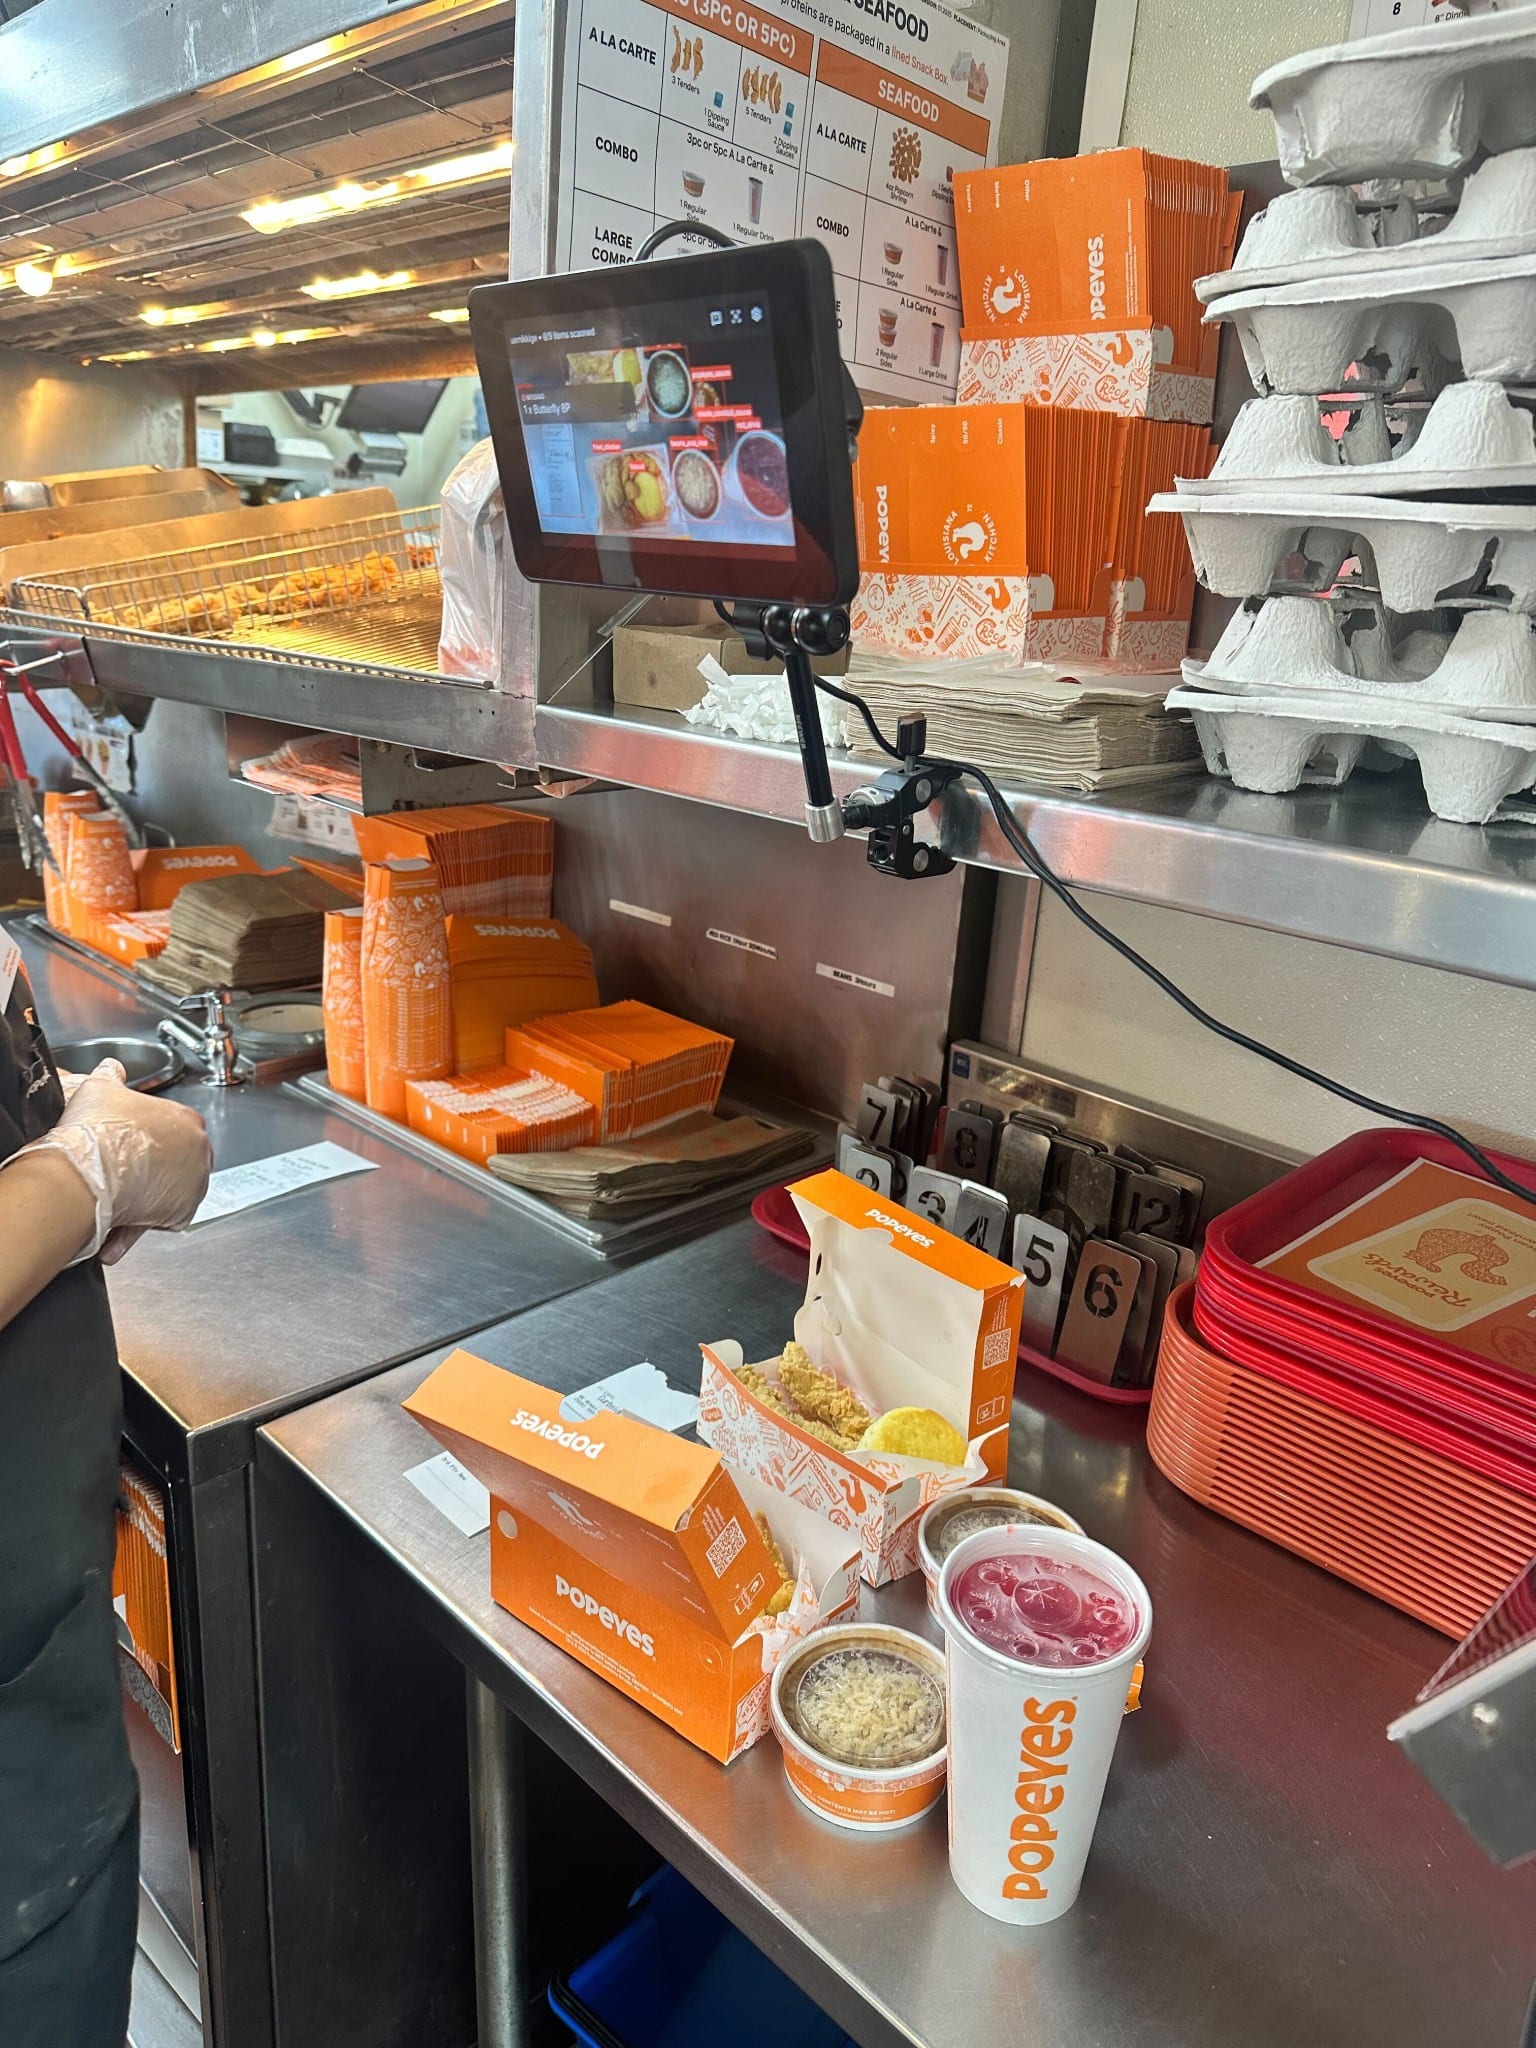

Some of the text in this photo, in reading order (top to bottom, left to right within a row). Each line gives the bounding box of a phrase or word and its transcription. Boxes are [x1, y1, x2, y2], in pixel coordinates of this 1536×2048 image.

[1392, 2, 1401, 15] 8
[1445, 11, 1468, 22] Dinn
[589, 27, 657, 65] A LA CARTE
[735, 11, 758, 40] OR
[760, 23, 796, 58] 5PC)
[818, 13, 834, 27] are
[834, 18, 875, 47] packaged
[876, 35, 884, 50] in
[885, 46, 890, 55] a
[891, 45, 910, 66] lined
[911, 55, 933, 77] Snack
[934, 69, 949, 86] Box.
[671, 76, 700, 95] 3 Tenders
[878, 79, 939, 122] SEAFOOD
[707, 108, 730, 126] Dipping
[707, 118, 725, 132] Sauce
[745, 107, 772, 125] 5 Tenders
[595, 136, 638, 163] COMBO
[774, 136, 798, 155] 2 Dipping
[817, 123, 867, 154] A LA CARTE
[686, 132, 775, 176] 3pc or 5pc A La Carte &
[890, 192, 908, 205] Shrimp
[894, 184, 914, 199] Popcorn
[683, 200, 707, 216] Regular
[595, 226, 633, 250] LARGE
[736, 223, 759, 241] Regular
[816, 216, 849, 237] COMBO
[905, 216, 943, 237] A La Carte &
[697, 238, 706, 246] or
[708, 237, 721, 250] 5p
[884, 267, 904, 280] Regular
[886, 278, 898, 288] Side
[900, 298, 937, 316] A La Carte &
[983, 274, 997, 323] KITCHEN
[1014, 268, 1031, 325] LOUISIANA
[876, 348, 898, 362] 2 Regular
[942, 510, 960, 566] LOUISIANA
[983, 513, 998, 563] KITCHEN
[865, 1098, 887, 1139] 7
[954, 1127, 979, 1170] 8
[917, 1190, 947, 1228] 3
[1131, 1191, 1172, 1233] 12
[961, 1214, 991, 1252] 4
[1022, 1234, 1055, 1287] 5
[1083, 1263, 1123, 1319] 6
[1362, 1253, 1472, 1307] Rewards
[852, 1808, 867, 1816] MAY
